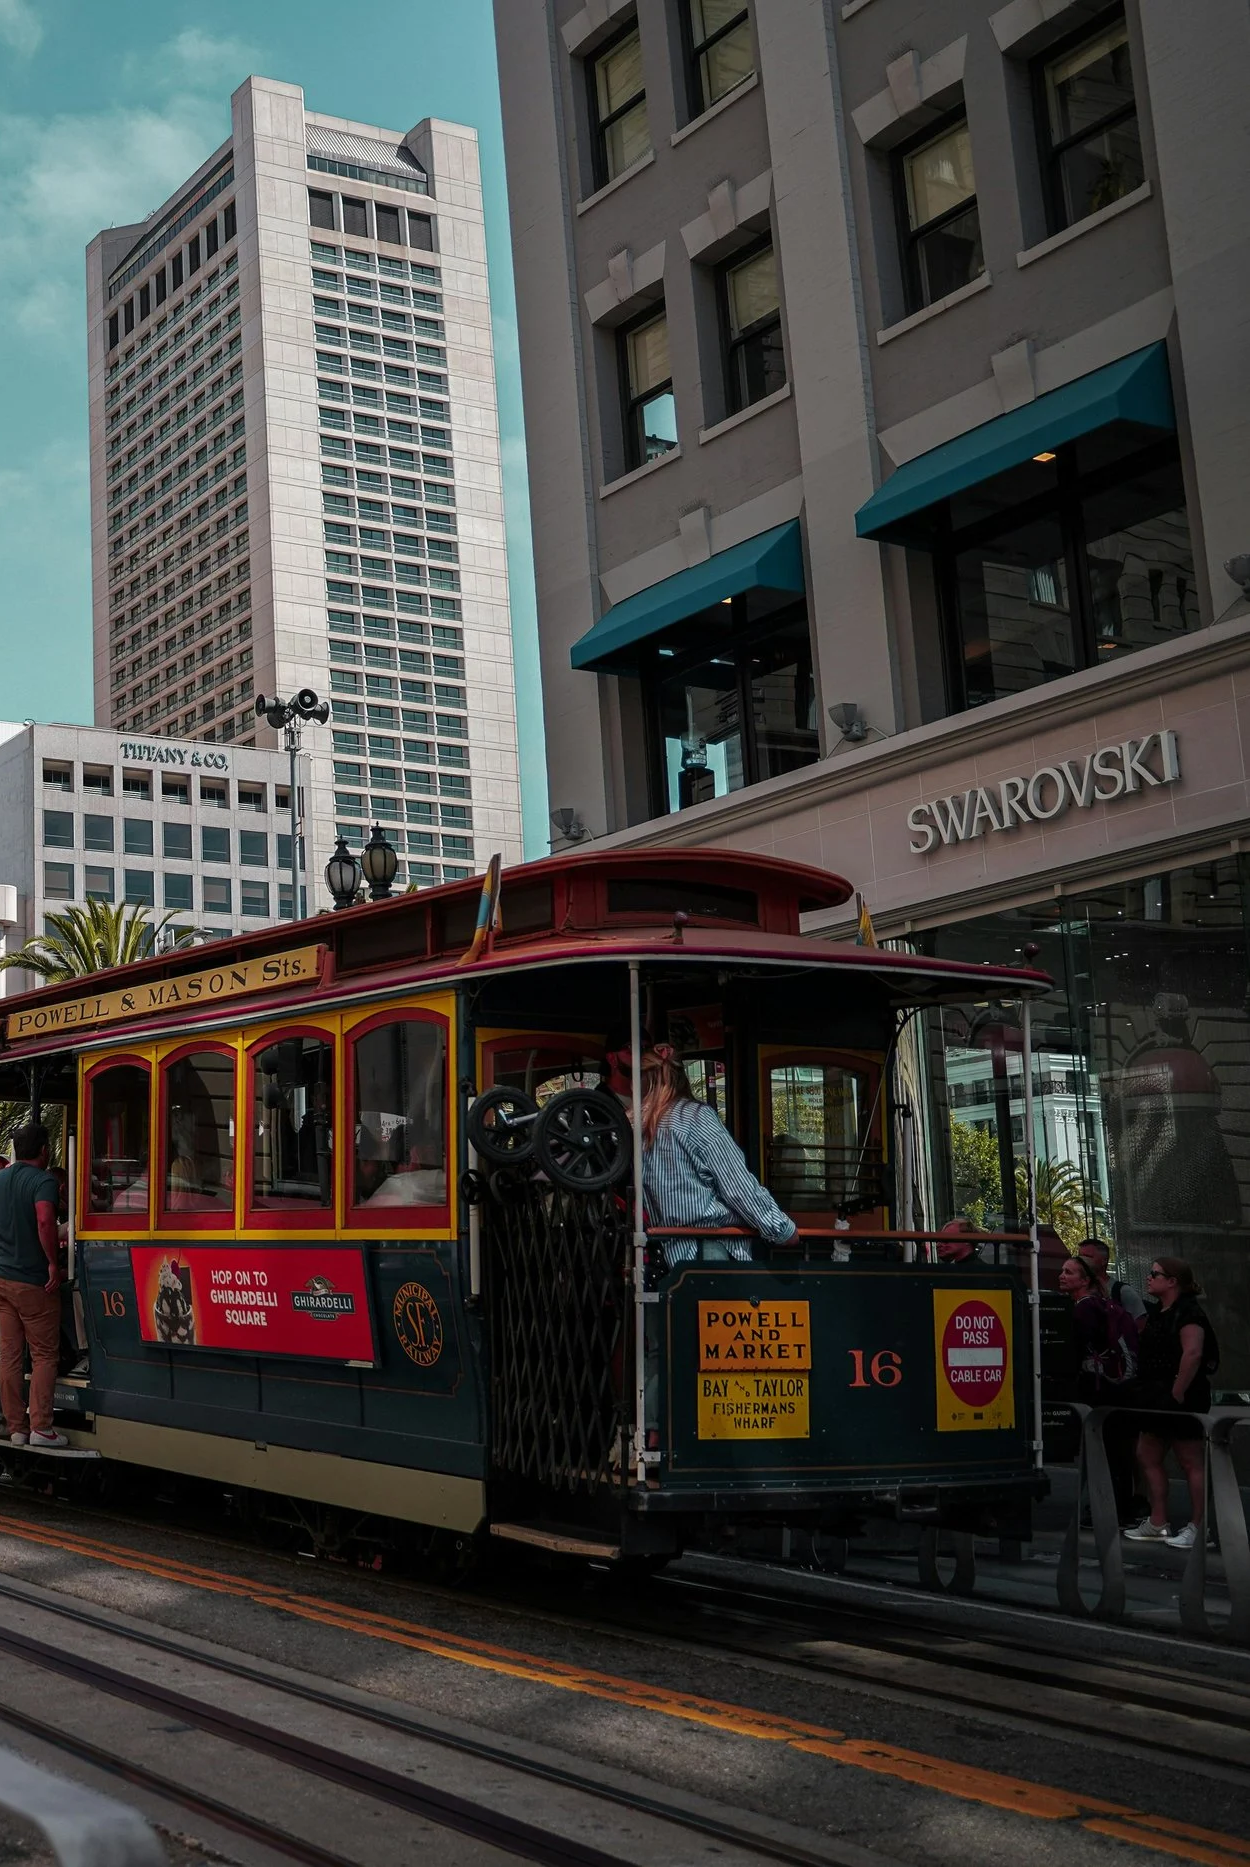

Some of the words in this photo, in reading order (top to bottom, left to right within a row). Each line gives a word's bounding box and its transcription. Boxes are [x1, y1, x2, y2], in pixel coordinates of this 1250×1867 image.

[119, 742, 188, 766] TIFFANY
[191, 751, 202, 768] &
[906, 729, 1181, 855] SWAROVSKI
[17, 1000, 110, 1033] POWELL
[120, 992, 136, 1013] &
[148, 968, 249, 1008] MASON
[262, 956, 307, 982] Sts.
[211, 1269, 232, 1286] HOP
[235, 1270, 250, 1286] ON
[252, 1271, 268, 1287] TO
[101, 1289, 127, 1318] 16
[210, 1288, 278, 1308] GHIRARDELLI
[293, 1295, 352, 1310] GHIRARDELLI
[394, 1284, 438, 1319] MUNICIPAL
[225, 1309, 268, 1327] SQUARE
[706, 1311, 804, 1328] POWELL
[955, 1316, 972, 1330] DO
[974, 1316, 995, 1330] NOT
[733, 1328, 781, 1341] AND
[962, 1331, 990, 1345] PASS
[399, 1333, 442, 1364] RAILWAY
[705, 1343, 807, 1360] MARKET
[848, 1350, 903, 1388] 16
[950, 1369, 982, 1384] CABLE
[983, 1369, 1002, 1383] CAR
[703, 1379, 729, 1398] BAY
[734, 1380, 751, 1398] AND
[754, 1379, 804, 1398] TAYLOR
[712, 1402, 796, 1416] FISHERMANS
[733, 1416, 776, 1429] WHARF
